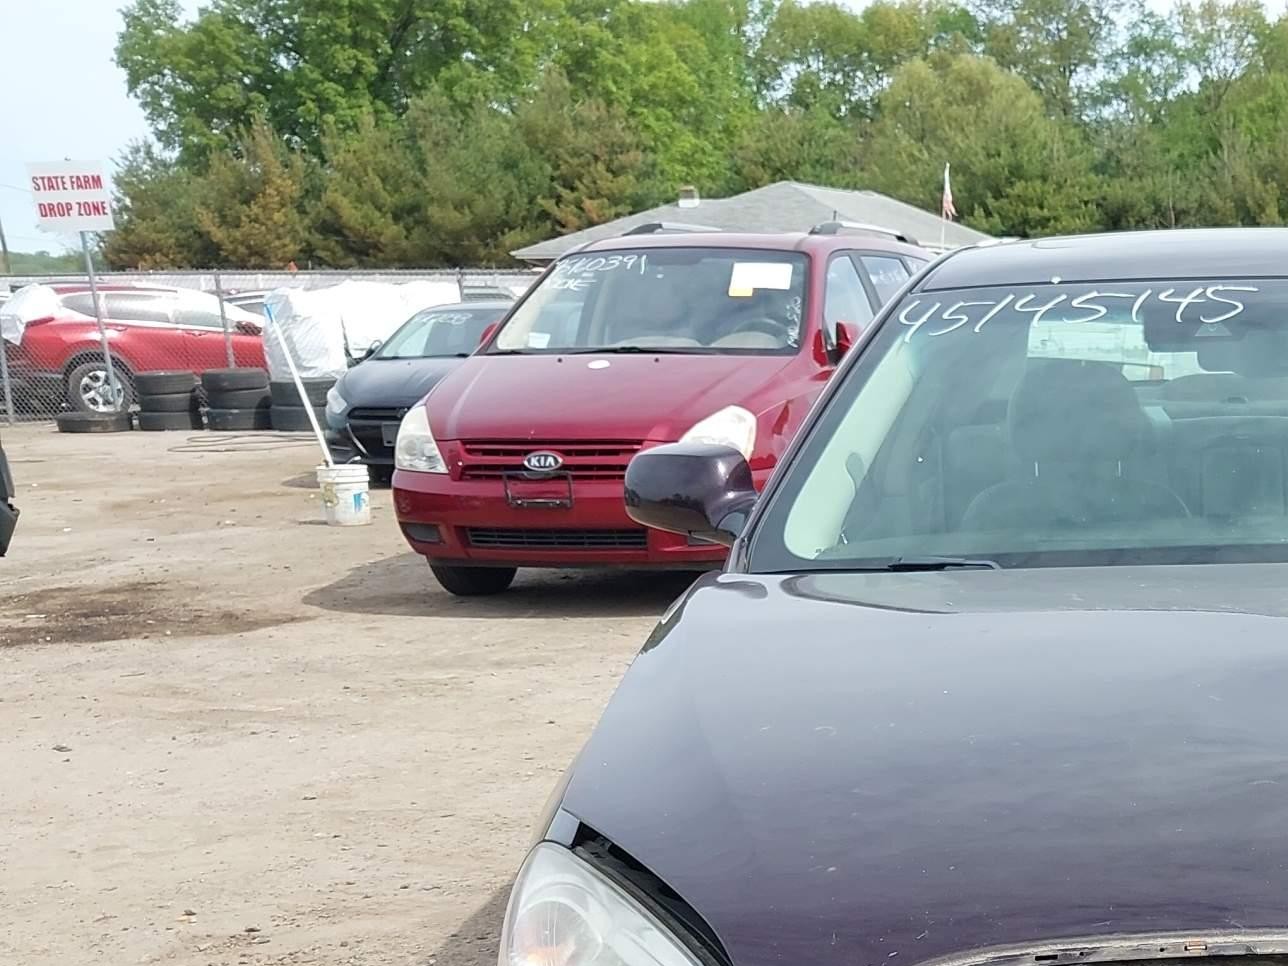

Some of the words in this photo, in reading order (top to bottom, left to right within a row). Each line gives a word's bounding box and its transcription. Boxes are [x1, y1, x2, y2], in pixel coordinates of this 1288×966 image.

[32, 175, 68, 191] STATE
[69, 174, 103, 190] FARM
[38, 202, 72, 217] DROP
[75, 201, 108, 216] ZONE
[899, 285, 1259, 343] 45145145
[530, 456, 556, 467] KIA
